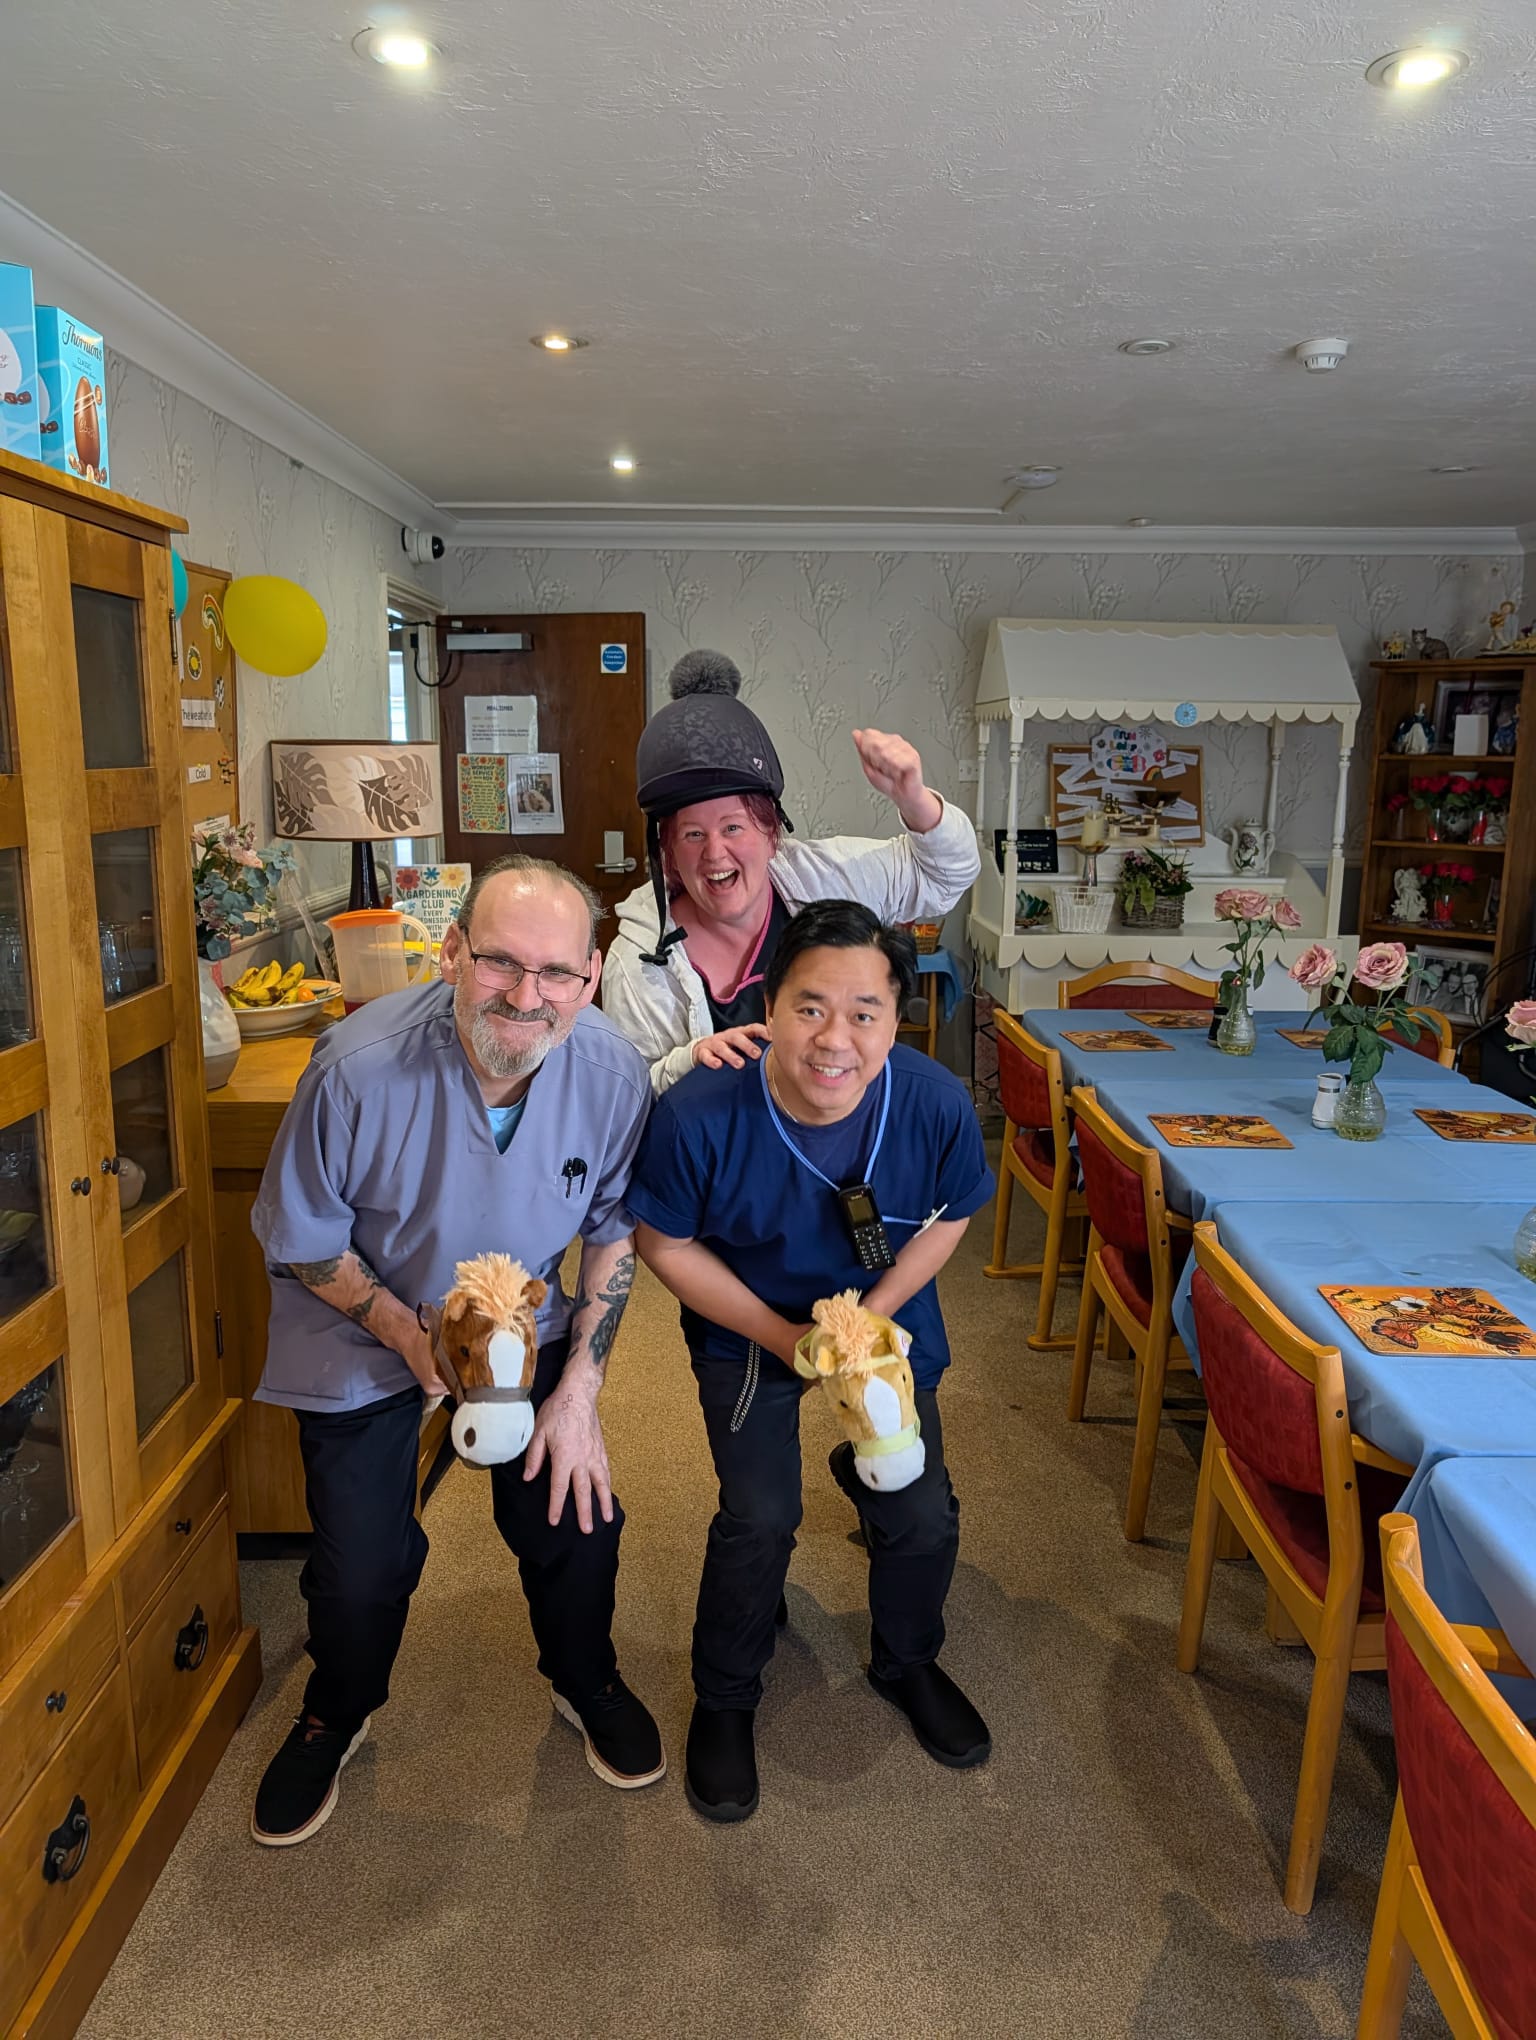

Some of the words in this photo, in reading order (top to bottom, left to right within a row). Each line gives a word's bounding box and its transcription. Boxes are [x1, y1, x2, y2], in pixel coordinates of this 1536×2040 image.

[195, 768, 207, 779] Cold
[406, 889, 458, 899] GARDENING
[421, 900, 445, 909] CLUB
